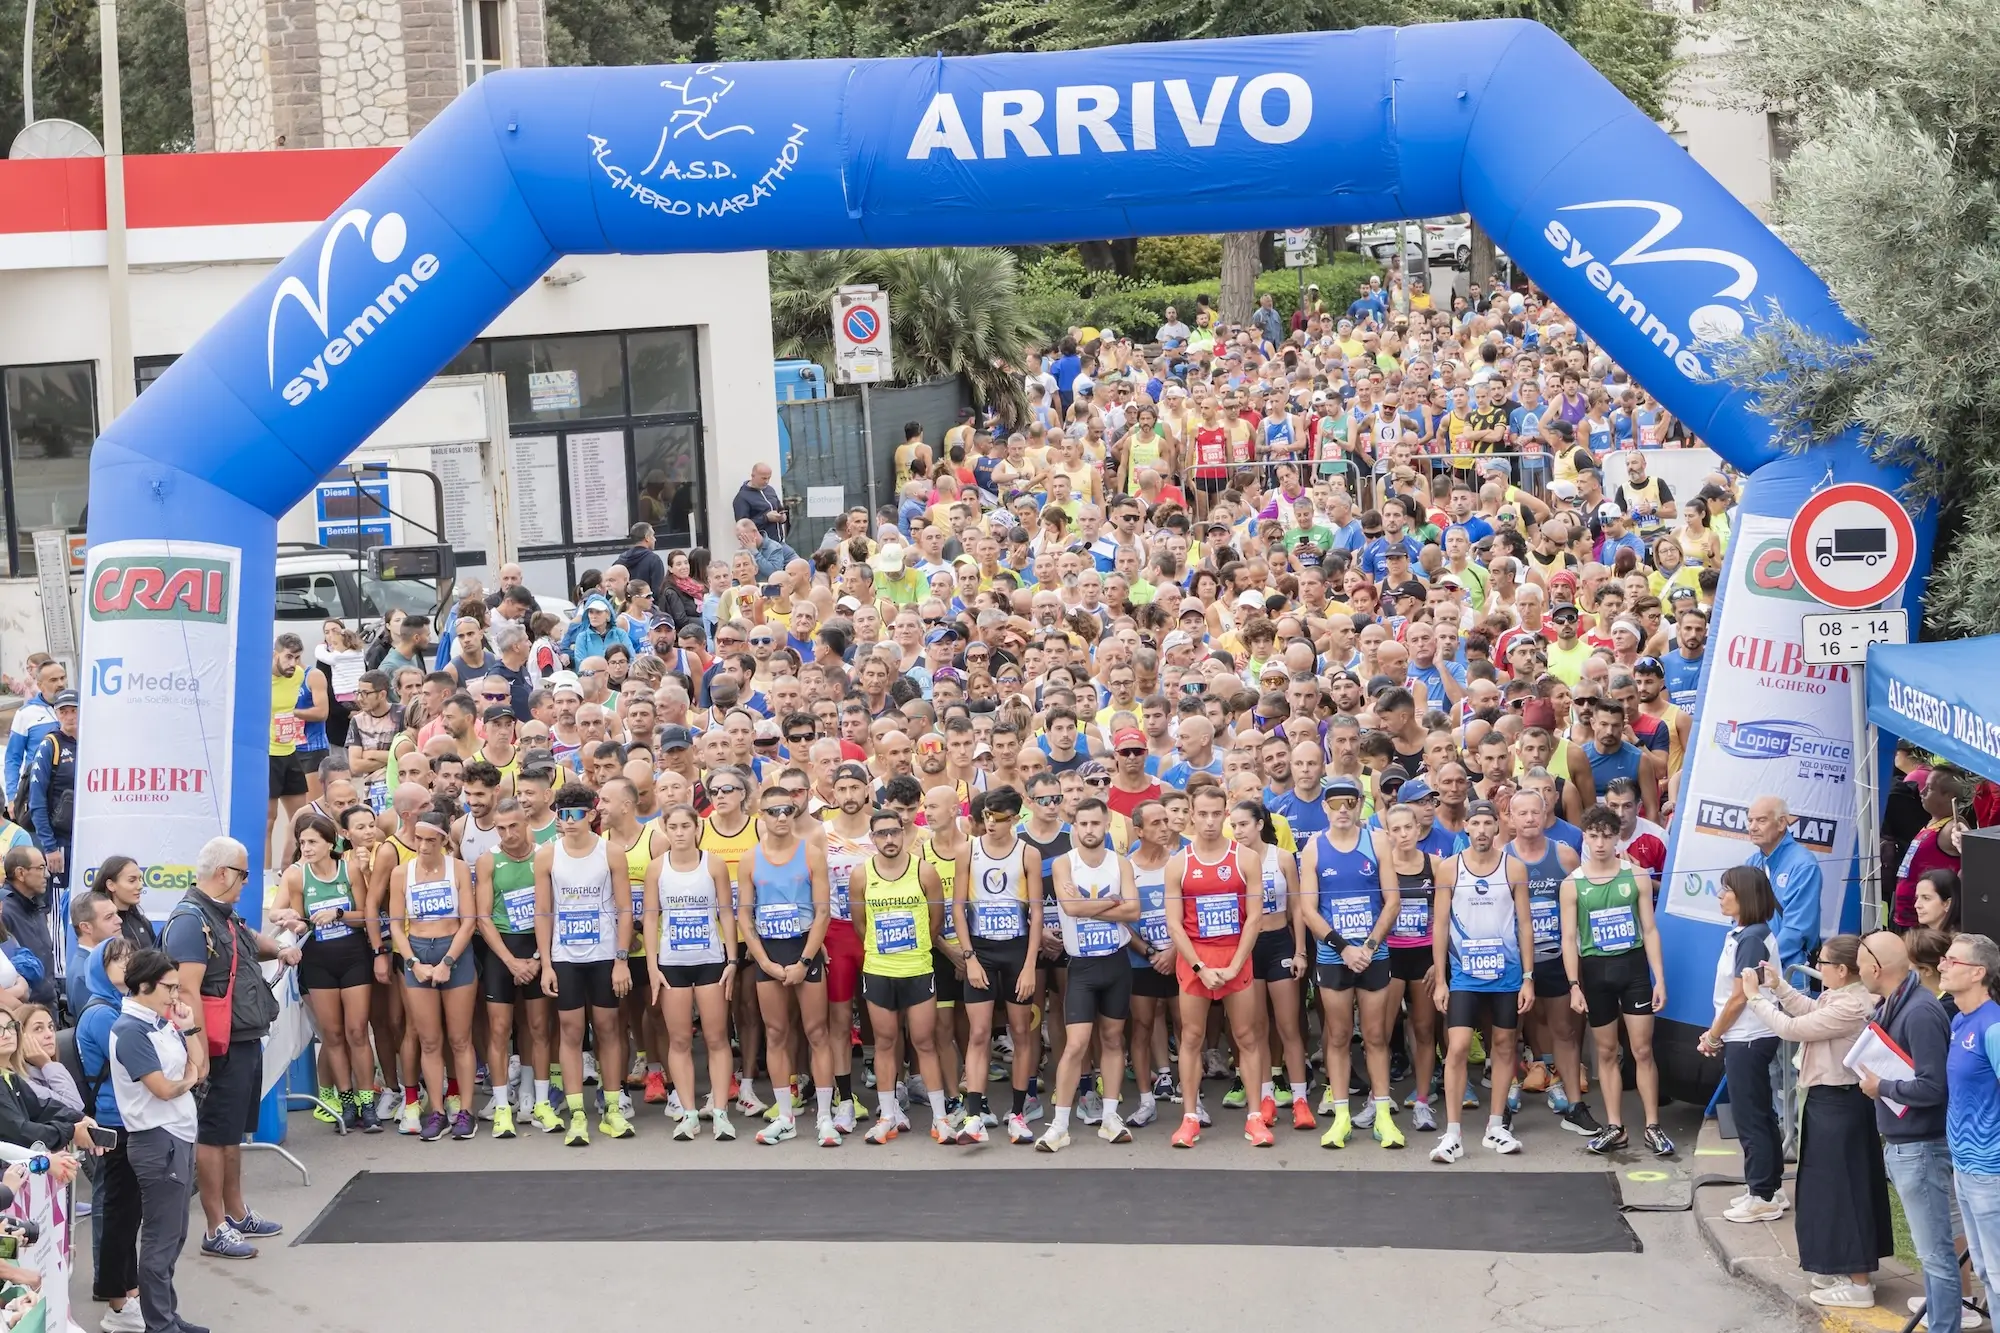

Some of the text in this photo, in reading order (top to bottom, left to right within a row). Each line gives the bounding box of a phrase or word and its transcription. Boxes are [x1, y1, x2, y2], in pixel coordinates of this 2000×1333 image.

[906, 72, 1313, 161] ARRIVO
[587, 123, 809, 218] ALGHERO MARATHON
[659, 160, 737, 180] A.S.D.
[1544, 220, 1714, 381] syemme
[282, 253, 440, 406] syemme
[323, 488, 350, 497] Diesel
[94, 566, 223, 615] CRAI
[1819, 621, 1842, 637] 08
[1867, 620, 1889, 635] 14
[1819, 641, 1841, 656] 16
[127, 671, 200, 691] Medea
[1757, 676, 1827, 695] ALGHERO
[1888, 678, 1950, 735] ALGHERO
[1737, 729, 1850, 760] Copier Service
[87, 767, 208, 795] GILBERT
[111, 793, 170, 802] ALGHERO
[420, 898, 446, 913] 1634
[666, 895, 709, 904] TRIATHLON
[867, 895, 920, 908] TRIATHLON
[515, 905, 535, 919] 105
[1206, 910, 1232, 925] 1215
[1340, 912, 1366, 927] 1003
[567, 920, 592, 934] 1250
[767, 918, 793, 934] 1140
[986, 916, 1012, 930] 1133
[1532, 917, 1552, 932] 044
[677, 925, 703, 939] 1619
[883, 927, 909, 942] 1254
[1086, 930, 1111, 945] 1271
[1147, 925, 1168, 940] 113
[1600, 923, 1628, 940] 1218
[1470, 955, 1498, 970] 1068
